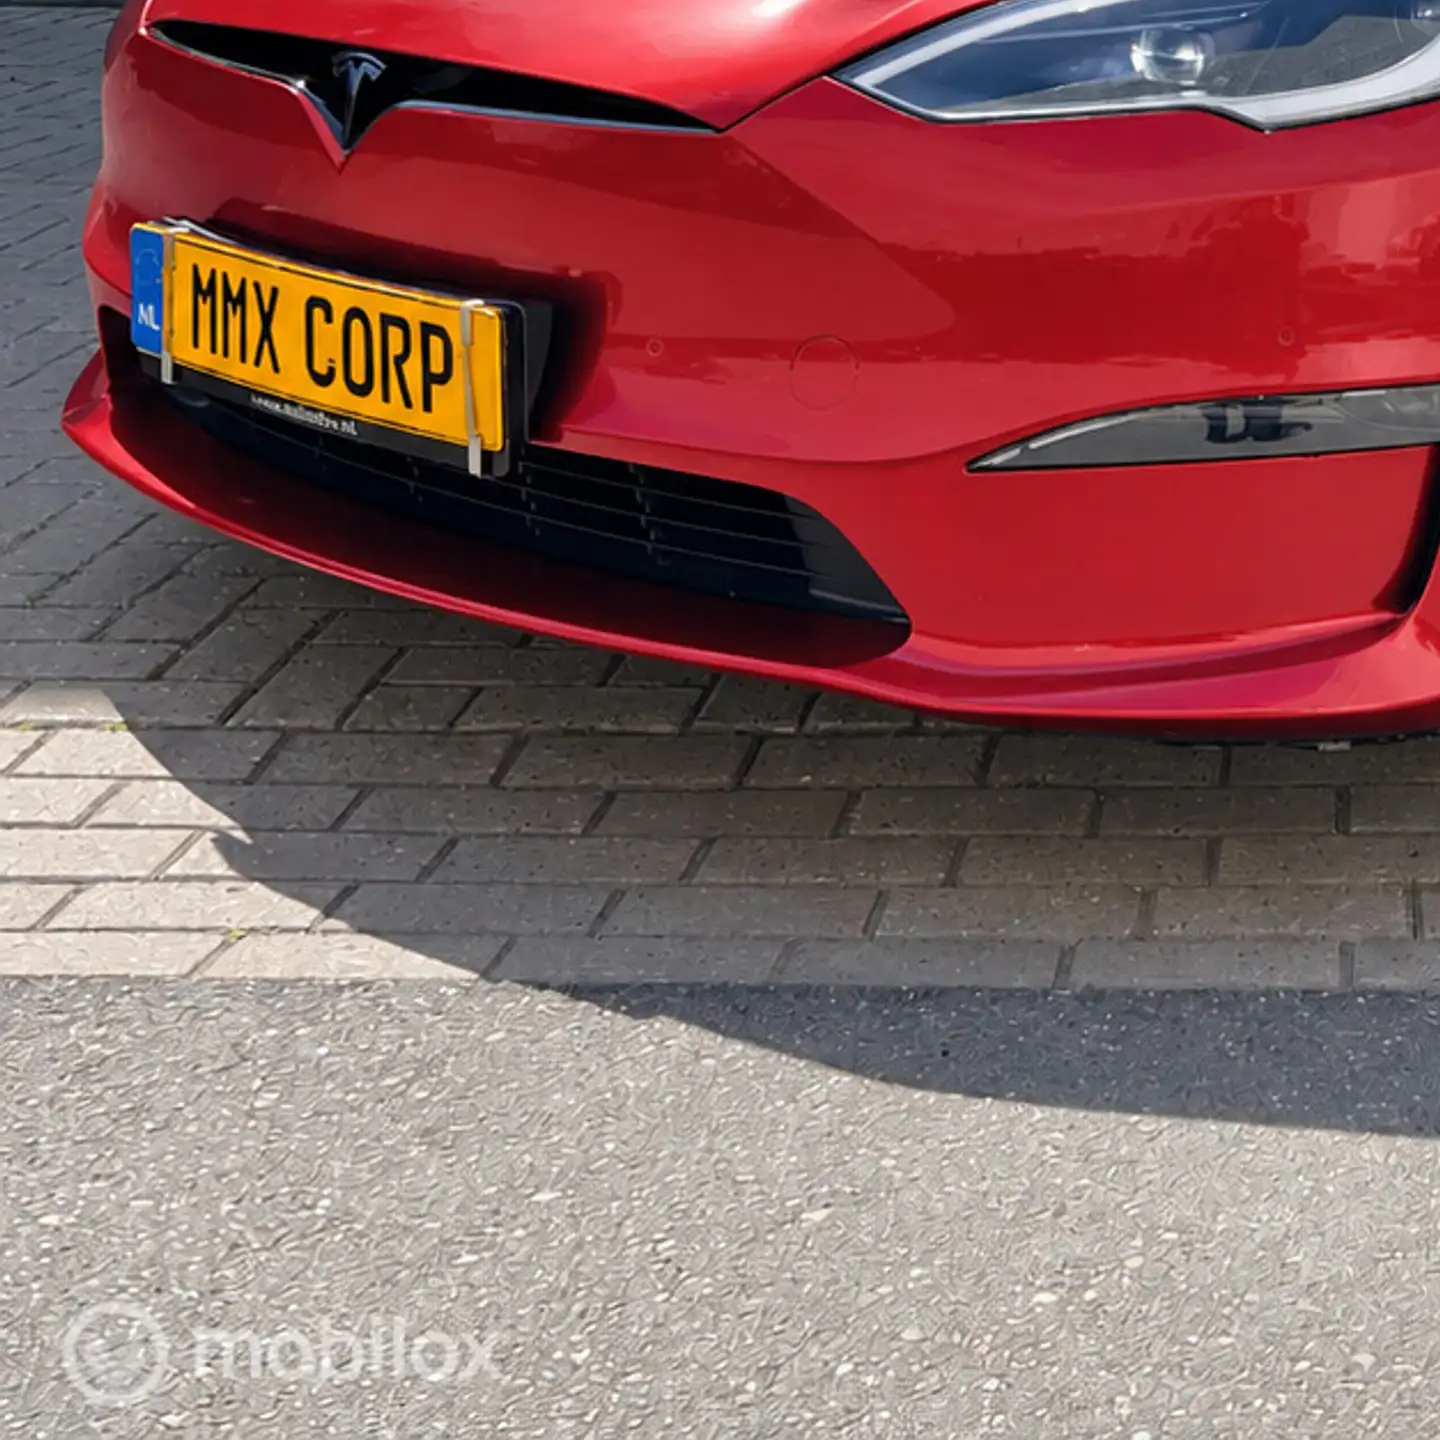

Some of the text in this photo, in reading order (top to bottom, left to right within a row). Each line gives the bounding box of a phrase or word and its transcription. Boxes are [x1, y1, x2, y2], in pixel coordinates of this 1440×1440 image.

[137, 303, 161, 332] NL
[191, 262, 454, 413] MMX CORP
